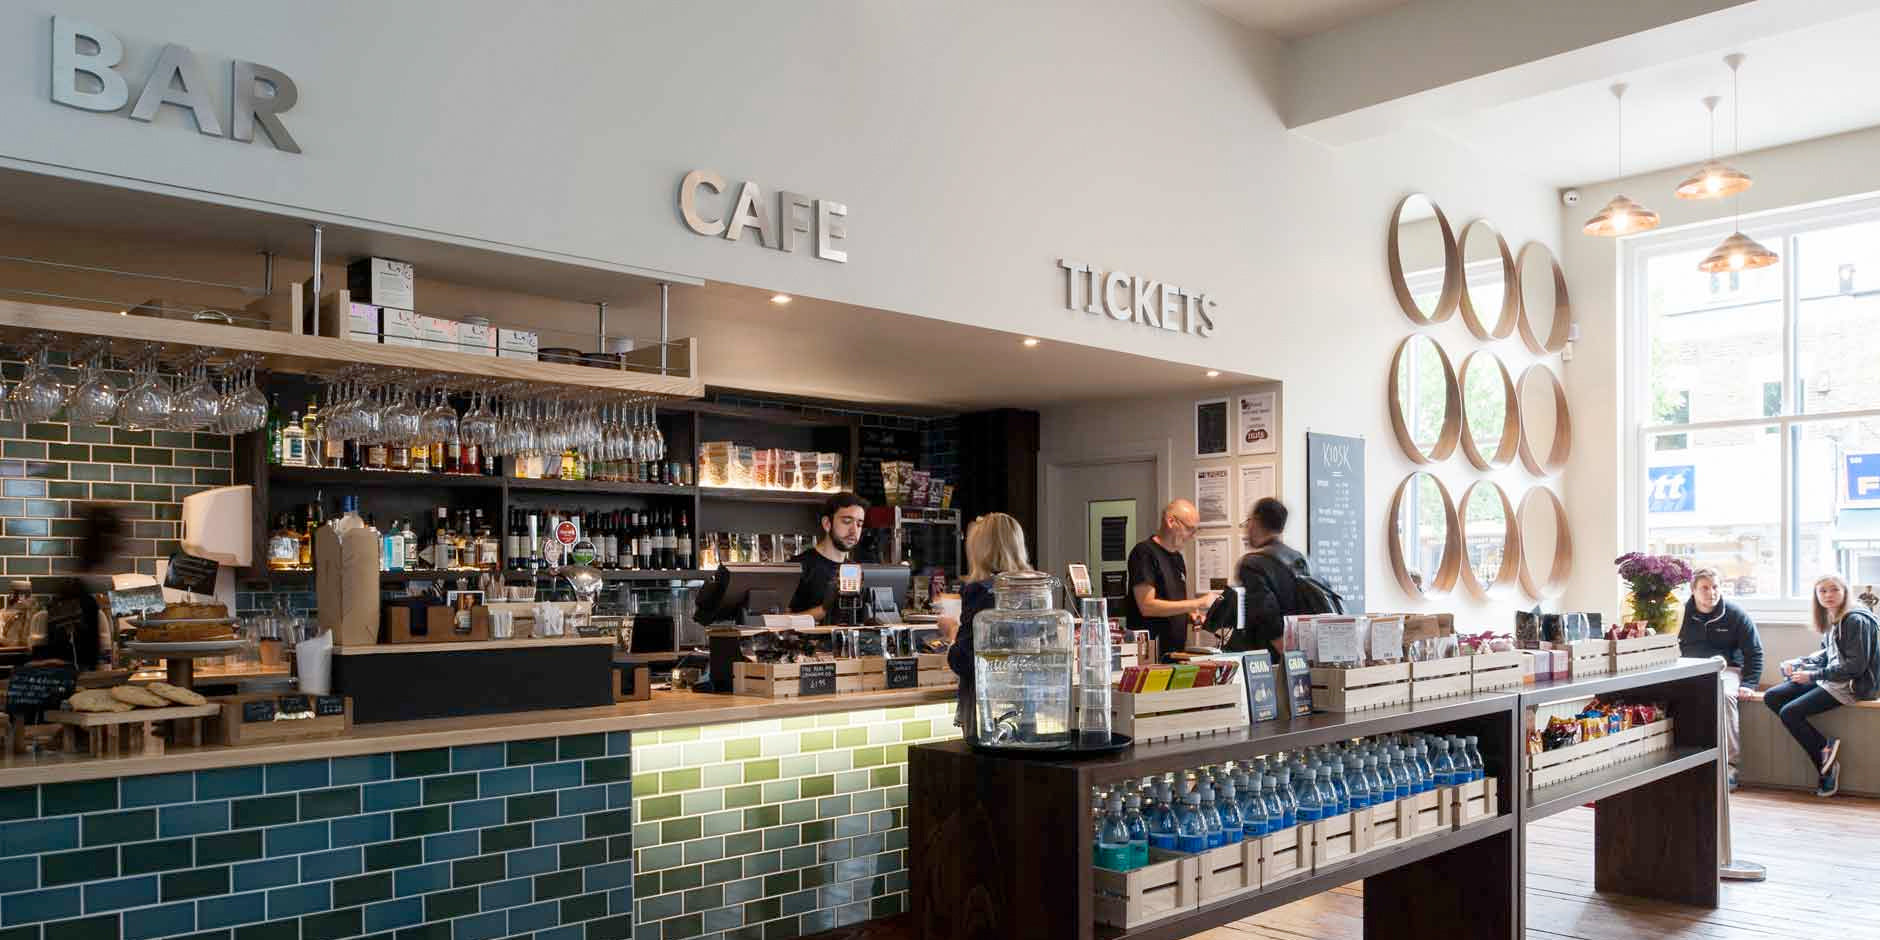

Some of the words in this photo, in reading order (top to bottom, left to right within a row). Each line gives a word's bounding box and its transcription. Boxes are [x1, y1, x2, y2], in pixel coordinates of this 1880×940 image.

[50, 15, 302, 154] BAR
[678, 169, 848, 264] CAFE
[1056, 257, 1217, 338] TICKETS
[1321, 442, 1352, 472] KIOSK
